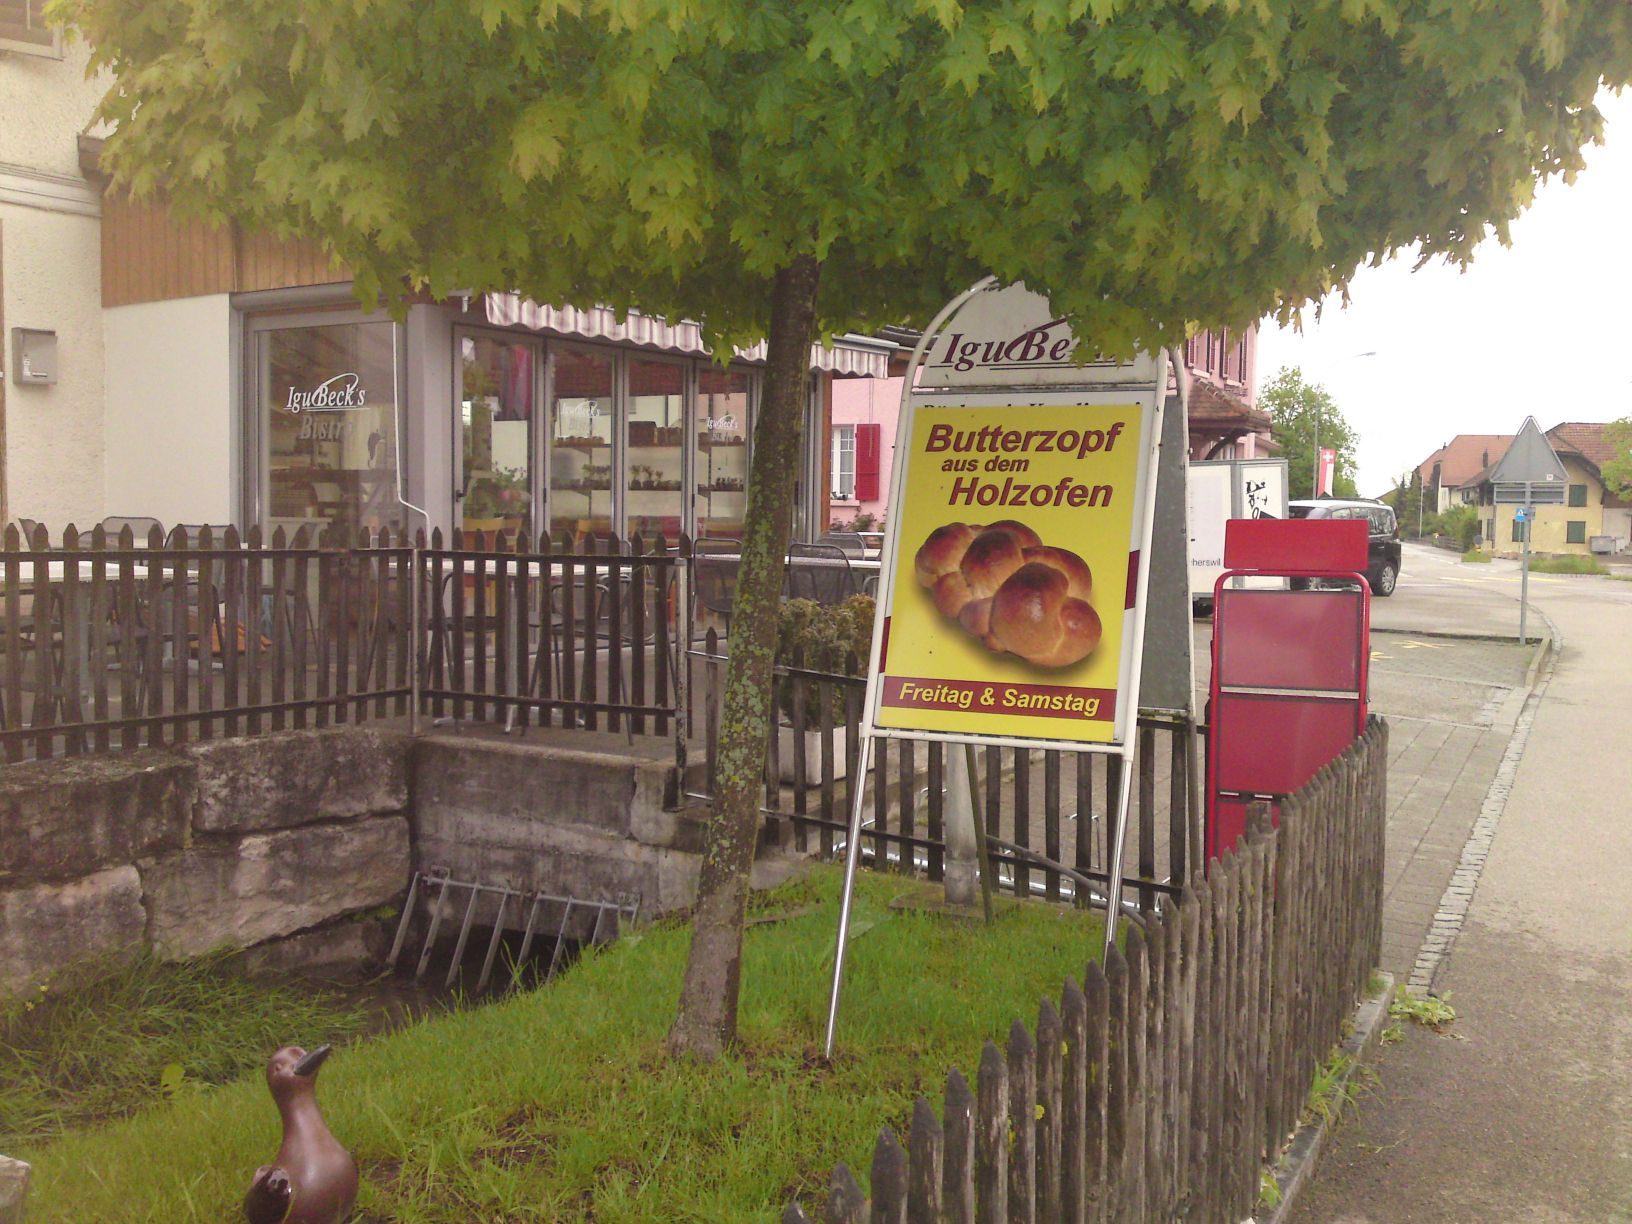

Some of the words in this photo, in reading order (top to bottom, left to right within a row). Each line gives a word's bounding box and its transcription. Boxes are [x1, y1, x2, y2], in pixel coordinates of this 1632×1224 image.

[941, 317, 1116, 372] IguBe
[299, 415, 353, 440] Bistr
[925, 422, 1125, 459] Butterzopf
[941, 457, 978, 472] aus
[984, 455, 1029, 472] dem
[948, 476, 1113, 507] Holzofen
[1191, 558, 1221, 567] herswil
[899, 682, 974, 709] Freitag
[979, 687, 996, 706] &
[1002, 688, 1101, 717] Samstag
